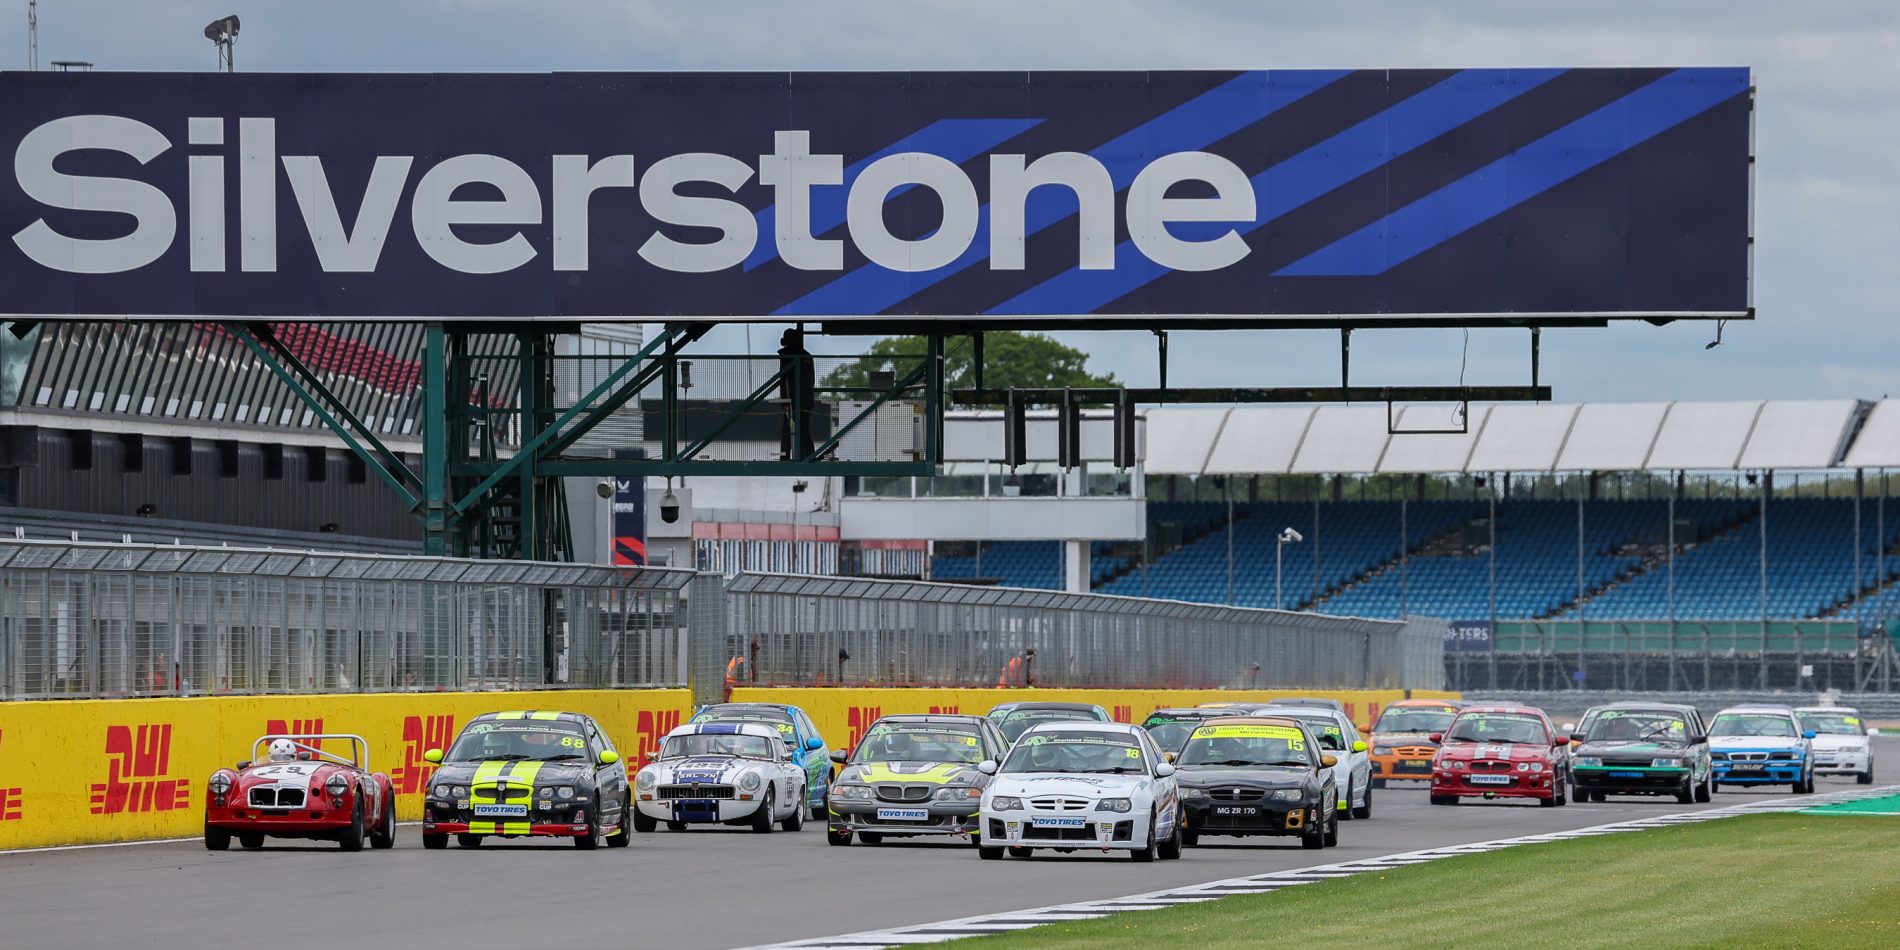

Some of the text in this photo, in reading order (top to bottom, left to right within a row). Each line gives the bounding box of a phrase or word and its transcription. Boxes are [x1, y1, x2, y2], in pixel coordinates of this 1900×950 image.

[12, 114, 1257, 274] Silverstone
[777, 724, 794, 734] 34
[1324, 726, 1339, 735] 58
[561, 737, 584, 748] 88
[1287, 740, 1304, 751] 15
[1124, 748, 1140, 758] 18
[103, 724, 178, 815] DHL
[267, 766, 302, 775] 29
[501, 806, 526, 814] TIRES
[1244, 807, 1256, 815] 170
